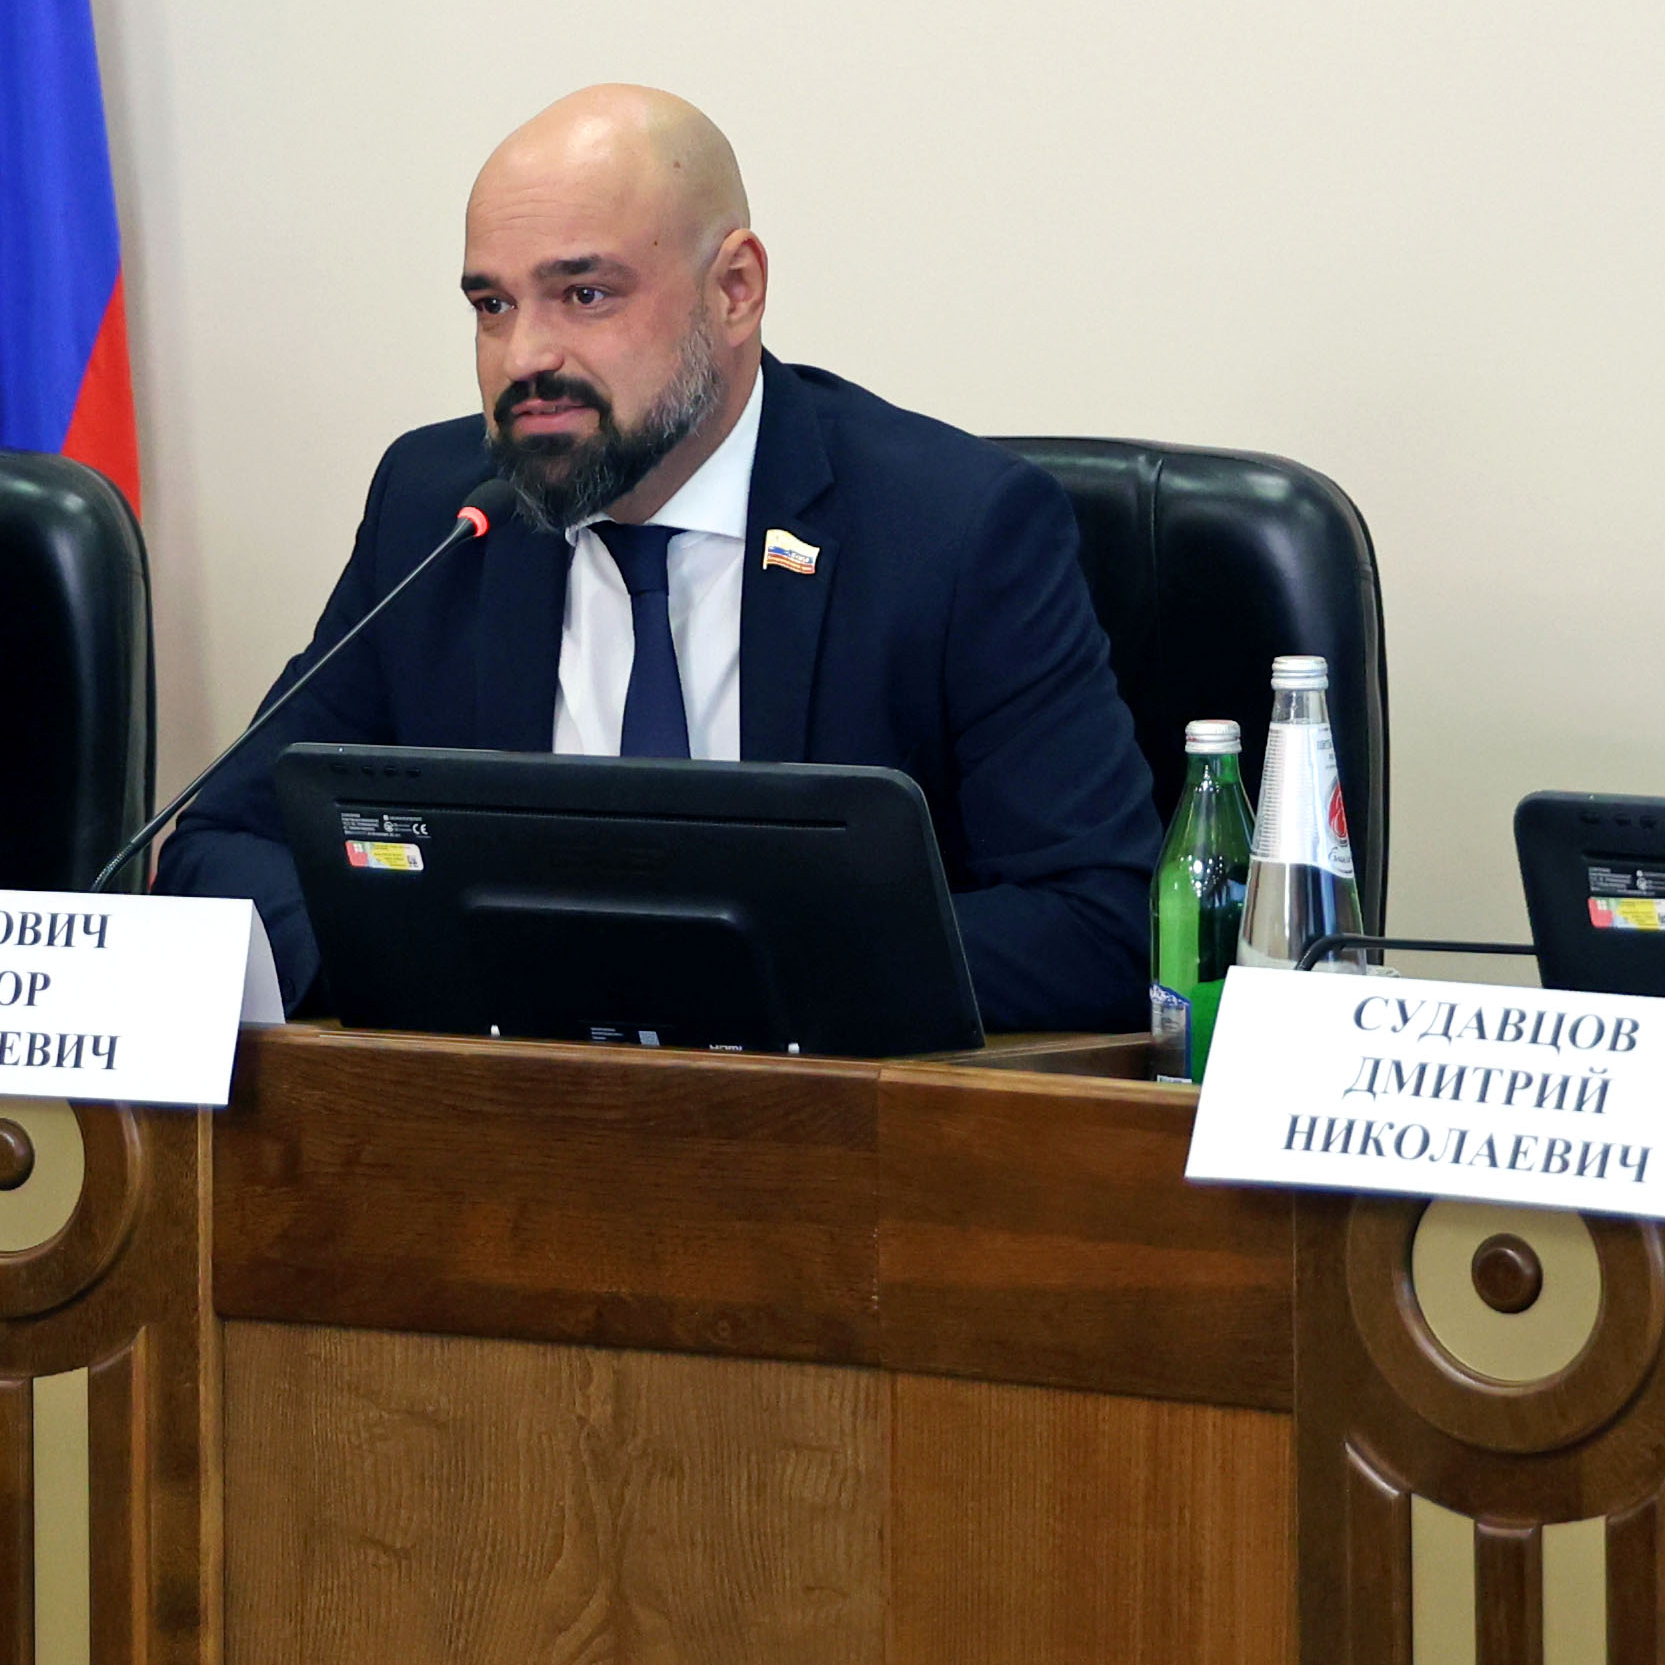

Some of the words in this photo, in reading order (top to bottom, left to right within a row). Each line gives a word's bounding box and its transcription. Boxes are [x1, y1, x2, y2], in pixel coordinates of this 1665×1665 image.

[1353, 996, 1640, 1054] СУДАВЦОВ
[1342, 1057, 1611, 1114] ДМИТРИЙ
[1282, 1114, 1652, 1183] НИКОЛАЕВИЧ
